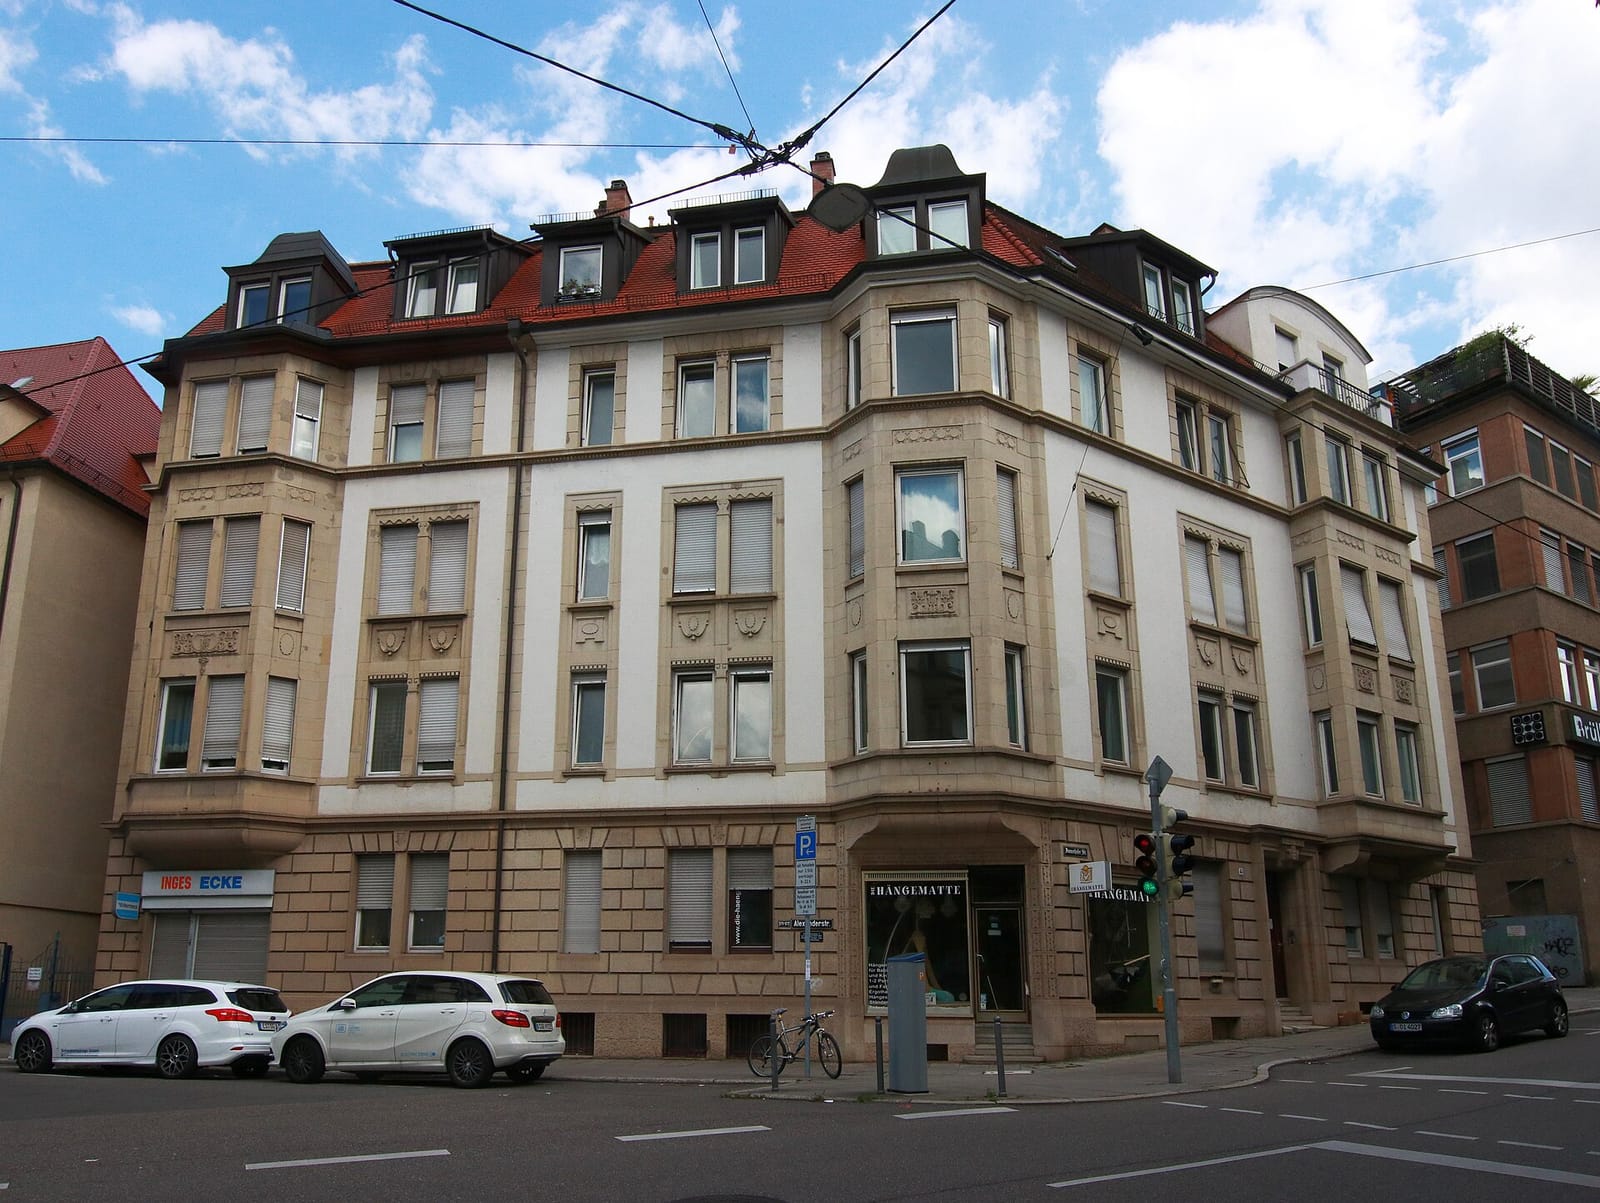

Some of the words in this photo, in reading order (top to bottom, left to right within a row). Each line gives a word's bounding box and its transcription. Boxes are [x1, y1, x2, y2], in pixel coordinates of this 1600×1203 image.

[800, 835, 811, 856] P
[161, 876, 192, 890] INGES
[200, 876, 242, 890] ECKE
[877, 885, 961, 896] HÄNGEMATTE
